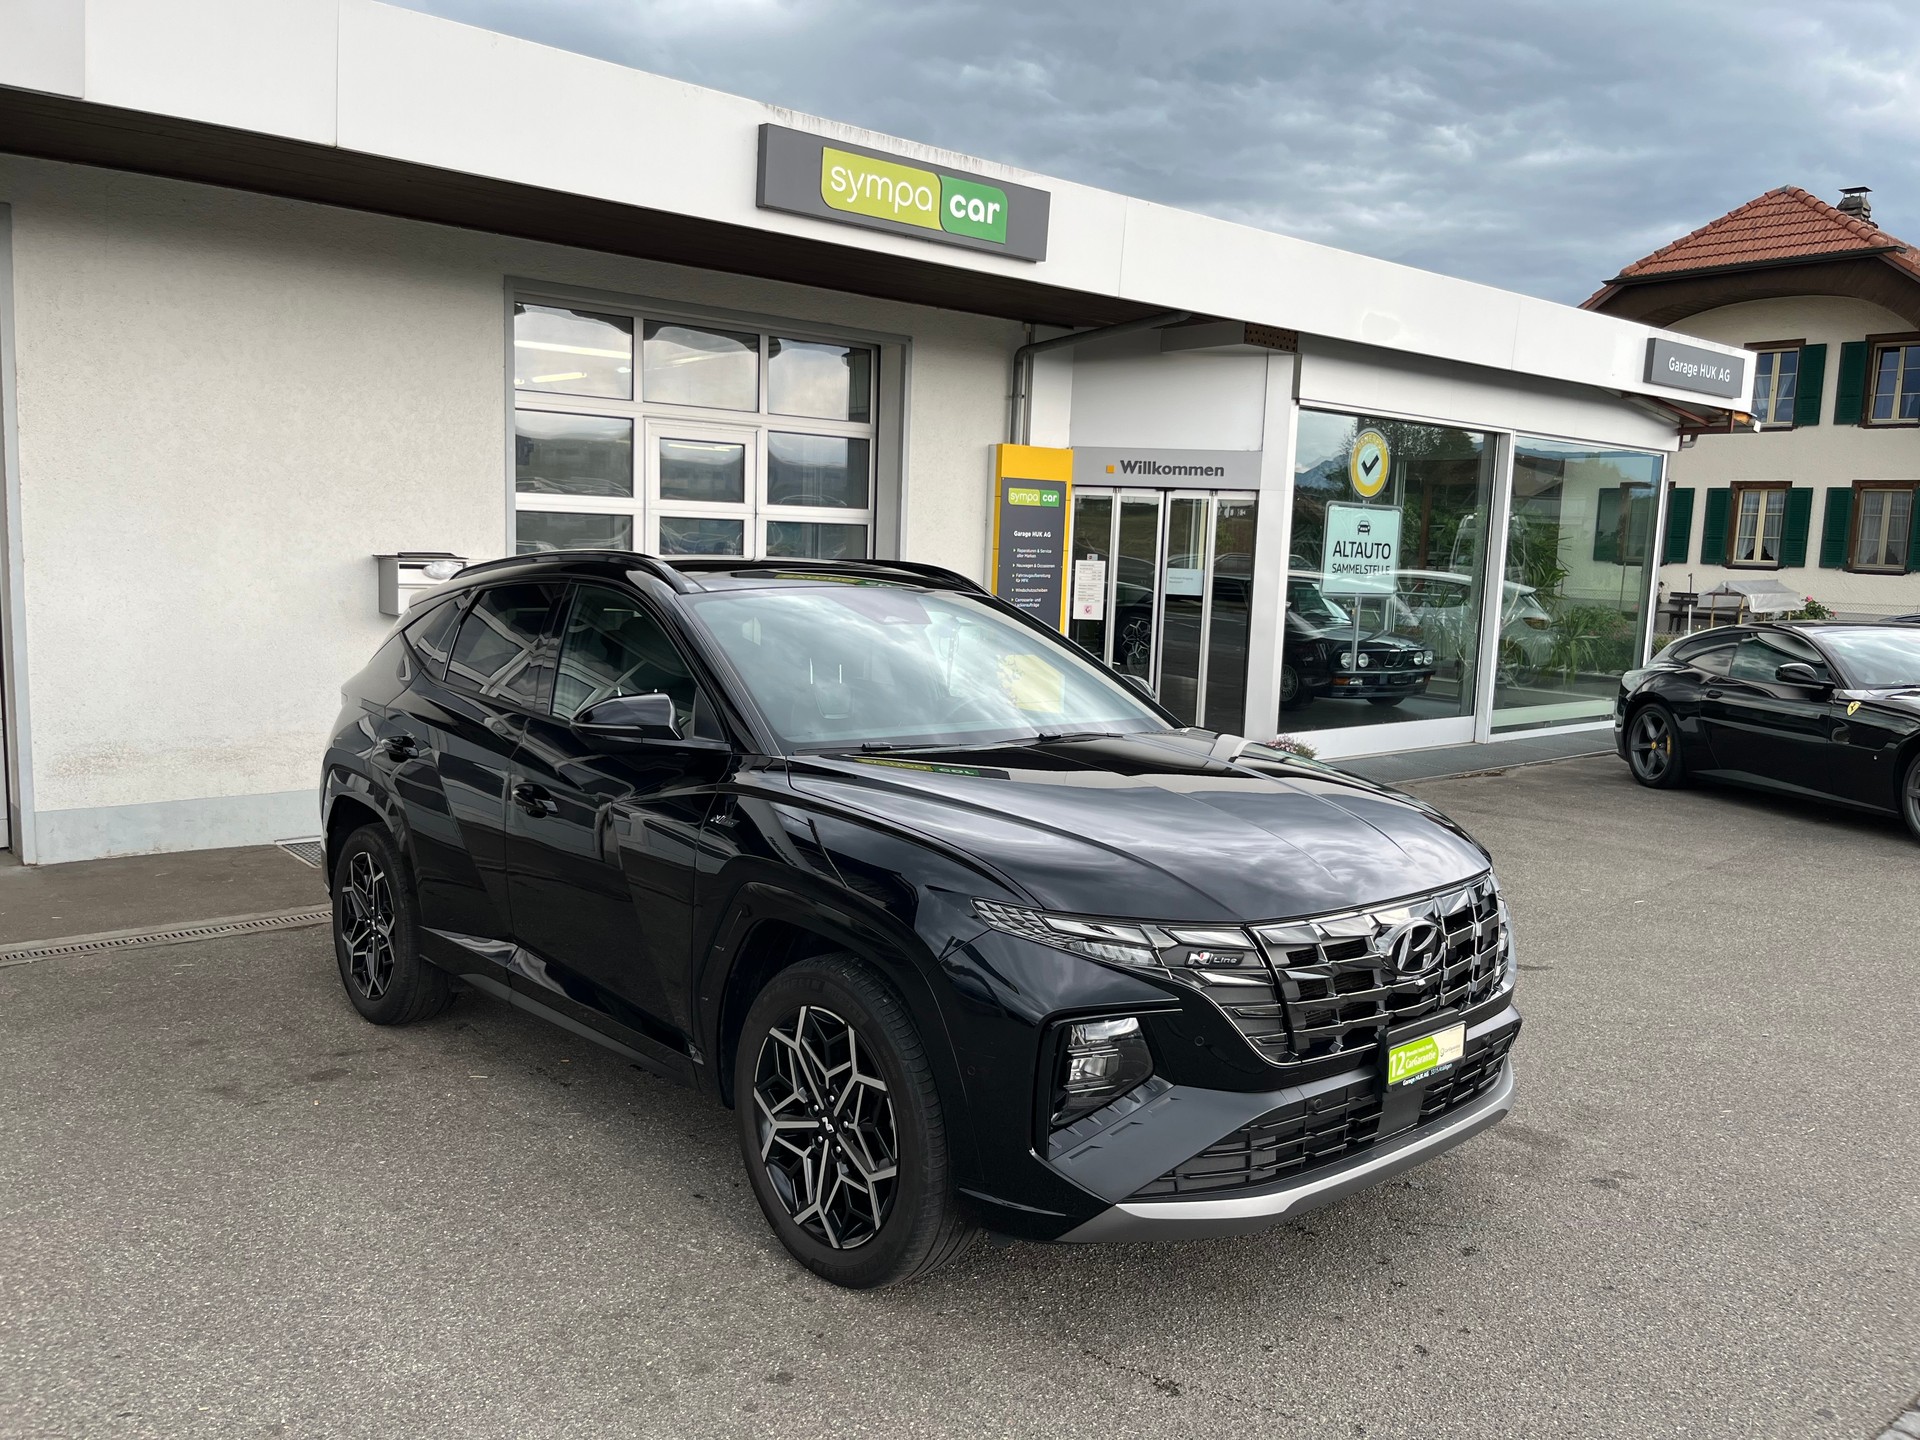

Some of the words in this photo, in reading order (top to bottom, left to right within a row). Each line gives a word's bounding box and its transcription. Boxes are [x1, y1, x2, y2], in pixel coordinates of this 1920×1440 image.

[831, 166, 933, 214] sympa
[949, 194, 1000, 225] car
[1669, 357, 1697, 377] Garage
[1700, 364, 1717, 380] HUK
[1718, 368, 1730, 382] AG
[1120, 460, 1224, 477] Willkommen
[1010, 492, 1038, 503] sympa
[1042, 494, 1057, 502] car
[1333, 541, 1391, 559] ALTAUTO
[1332, 563, 1390, 575] SAMMELSTELLE
[1390, 1051, 1406, 1078] 12
